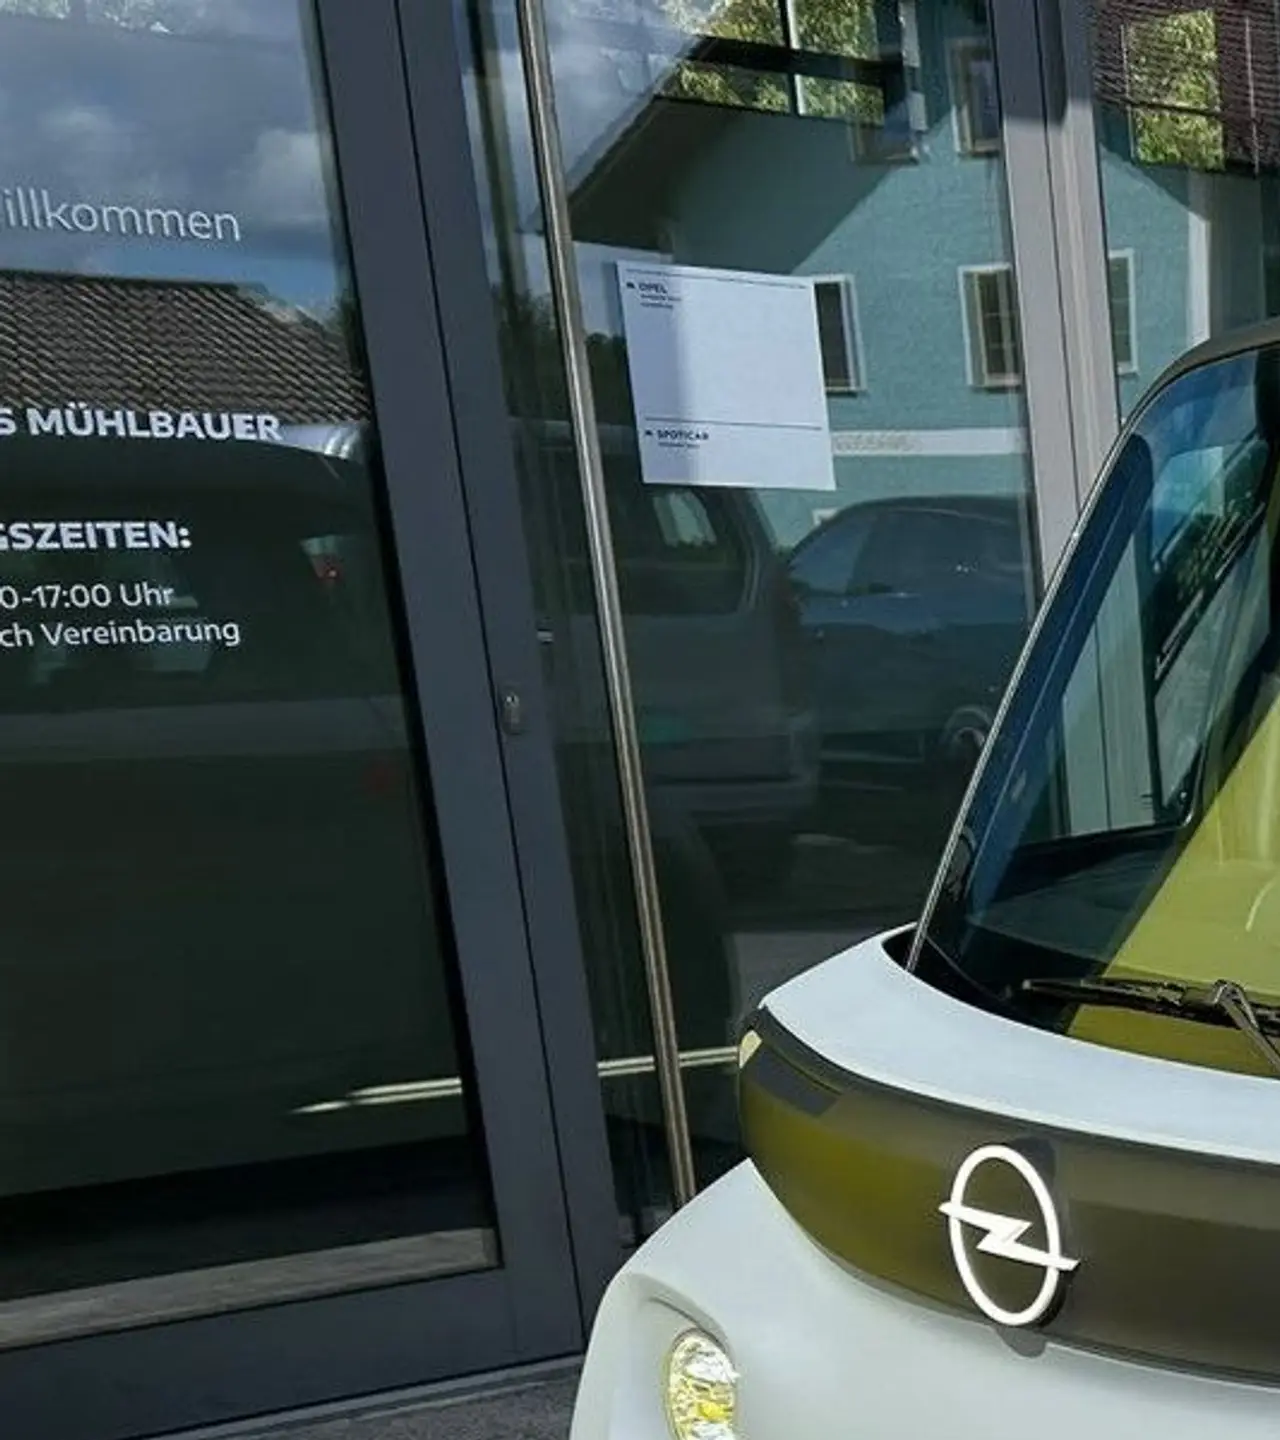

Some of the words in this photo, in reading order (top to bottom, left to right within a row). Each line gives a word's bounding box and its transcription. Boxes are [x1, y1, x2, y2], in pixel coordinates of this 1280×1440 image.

[27, 402, 282, 440] MÜHLBAUER
[0, 521, 192, 549] SZEITEN:
[120, 582, 174, 607] Uhr
[41, 619, 241, 647] Vereinbarung
